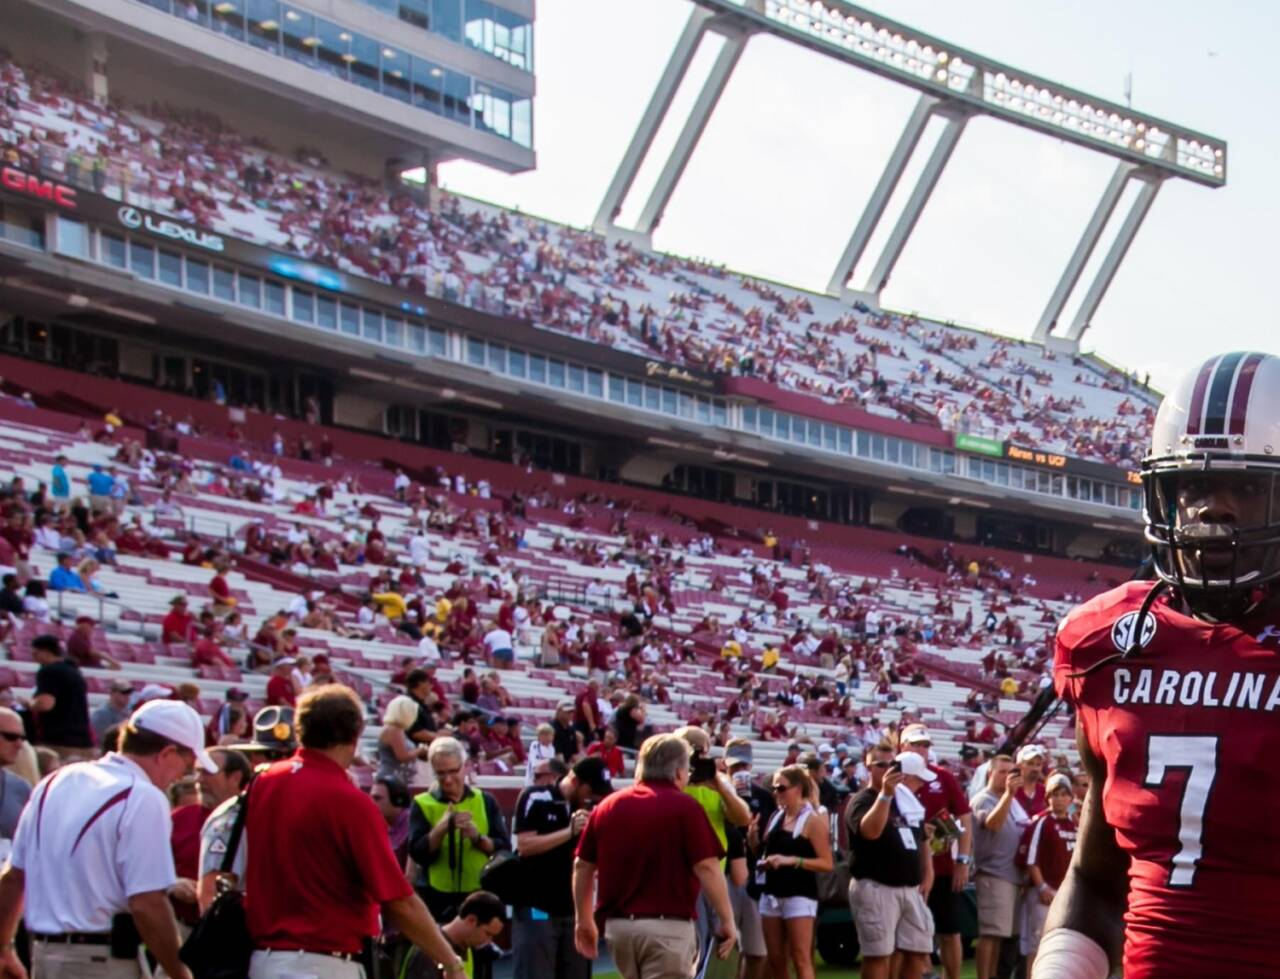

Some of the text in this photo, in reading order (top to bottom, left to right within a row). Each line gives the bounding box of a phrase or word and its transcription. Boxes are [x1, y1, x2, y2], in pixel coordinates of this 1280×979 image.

[1, 167, 78, 209] GMC
[145, 216, 225, 252] LEXUS
[1194, 437, 1229, 449] CAROLINA
[1145, 734, 1219, 887] 7
